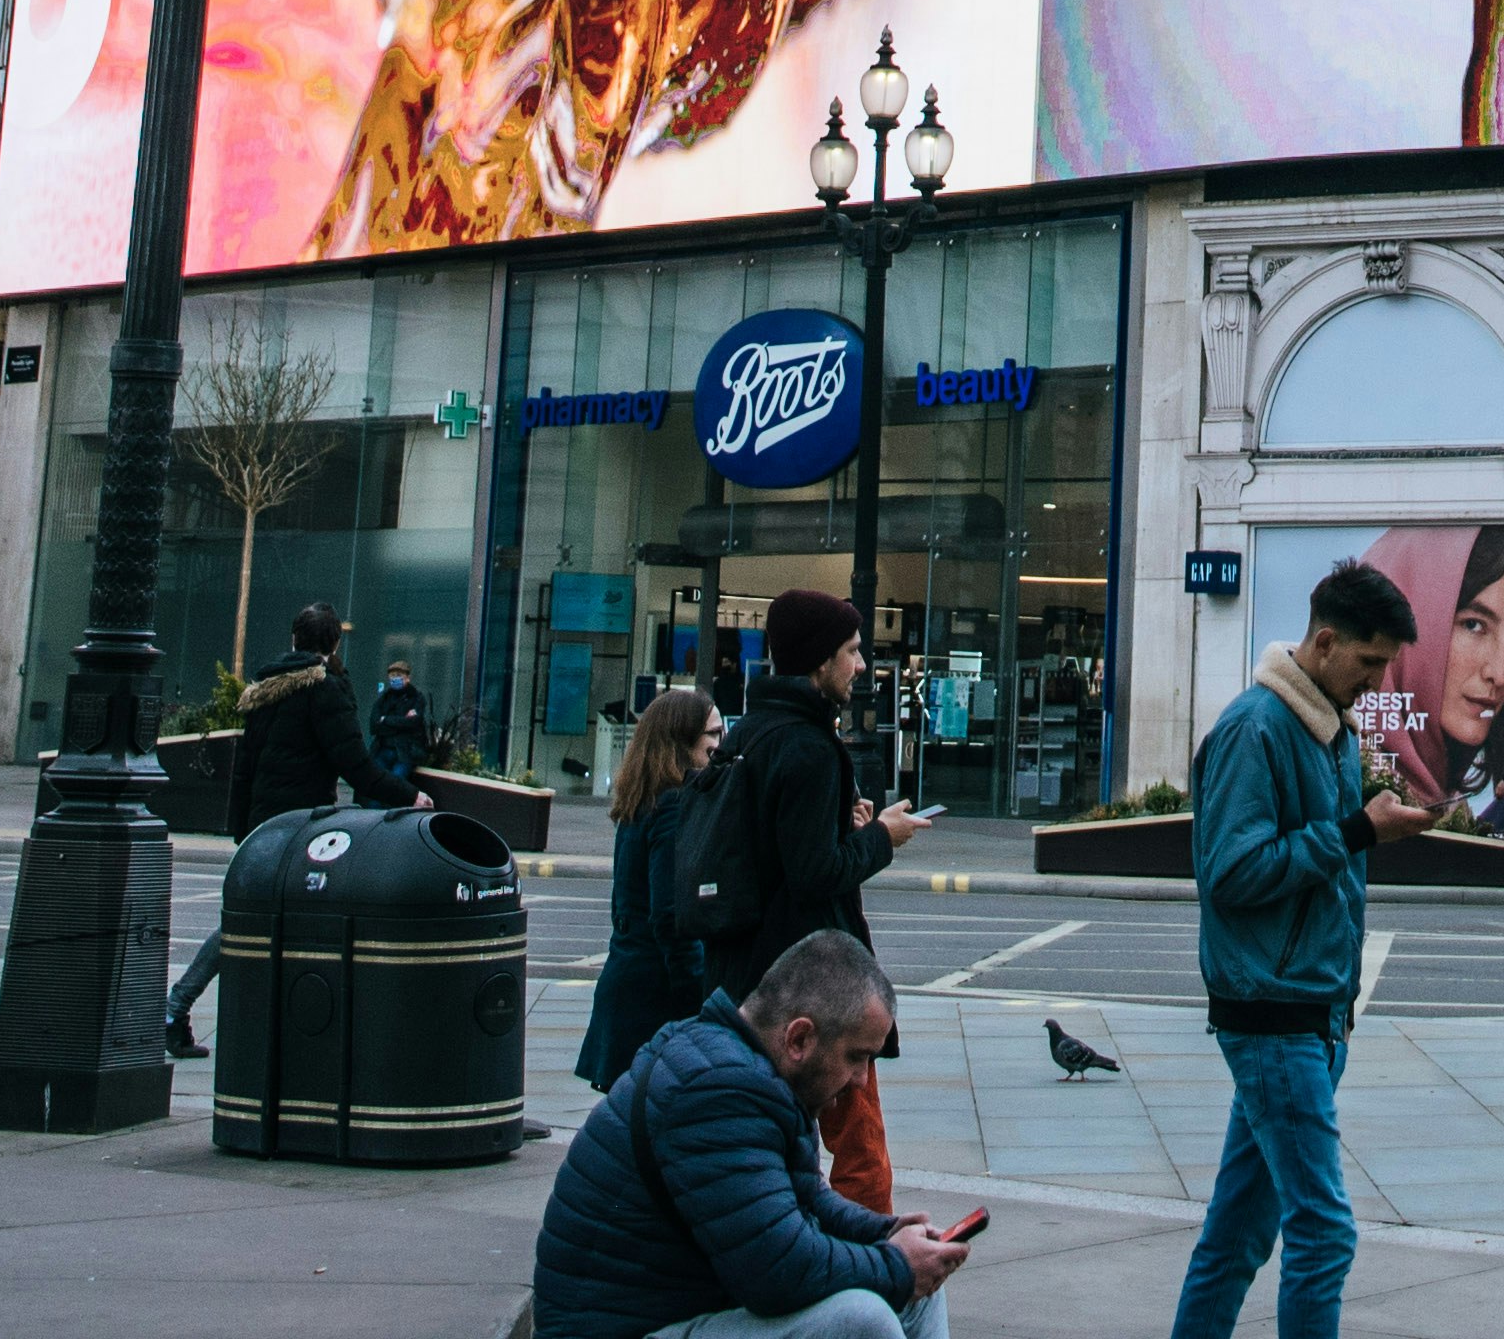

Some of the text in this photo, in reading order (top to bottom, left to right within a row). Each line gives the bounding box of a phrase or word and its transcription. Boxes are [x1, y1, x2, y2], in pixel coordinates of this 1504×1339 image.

[916, 358, 1039, 410] beauty
[706, 335, 848, 457] Boots
[521, 386, 670, 436] pharmacy
[1191, 562, 1213, 583] GAP
[1222, 563, 1237, 583] GAP
[1353, 691, 1415, 712] OSEST
[1381, 712, 1400, 731] IS
[1404, 712, 1429, 732] AT
[477, 885, 504, 900] general
